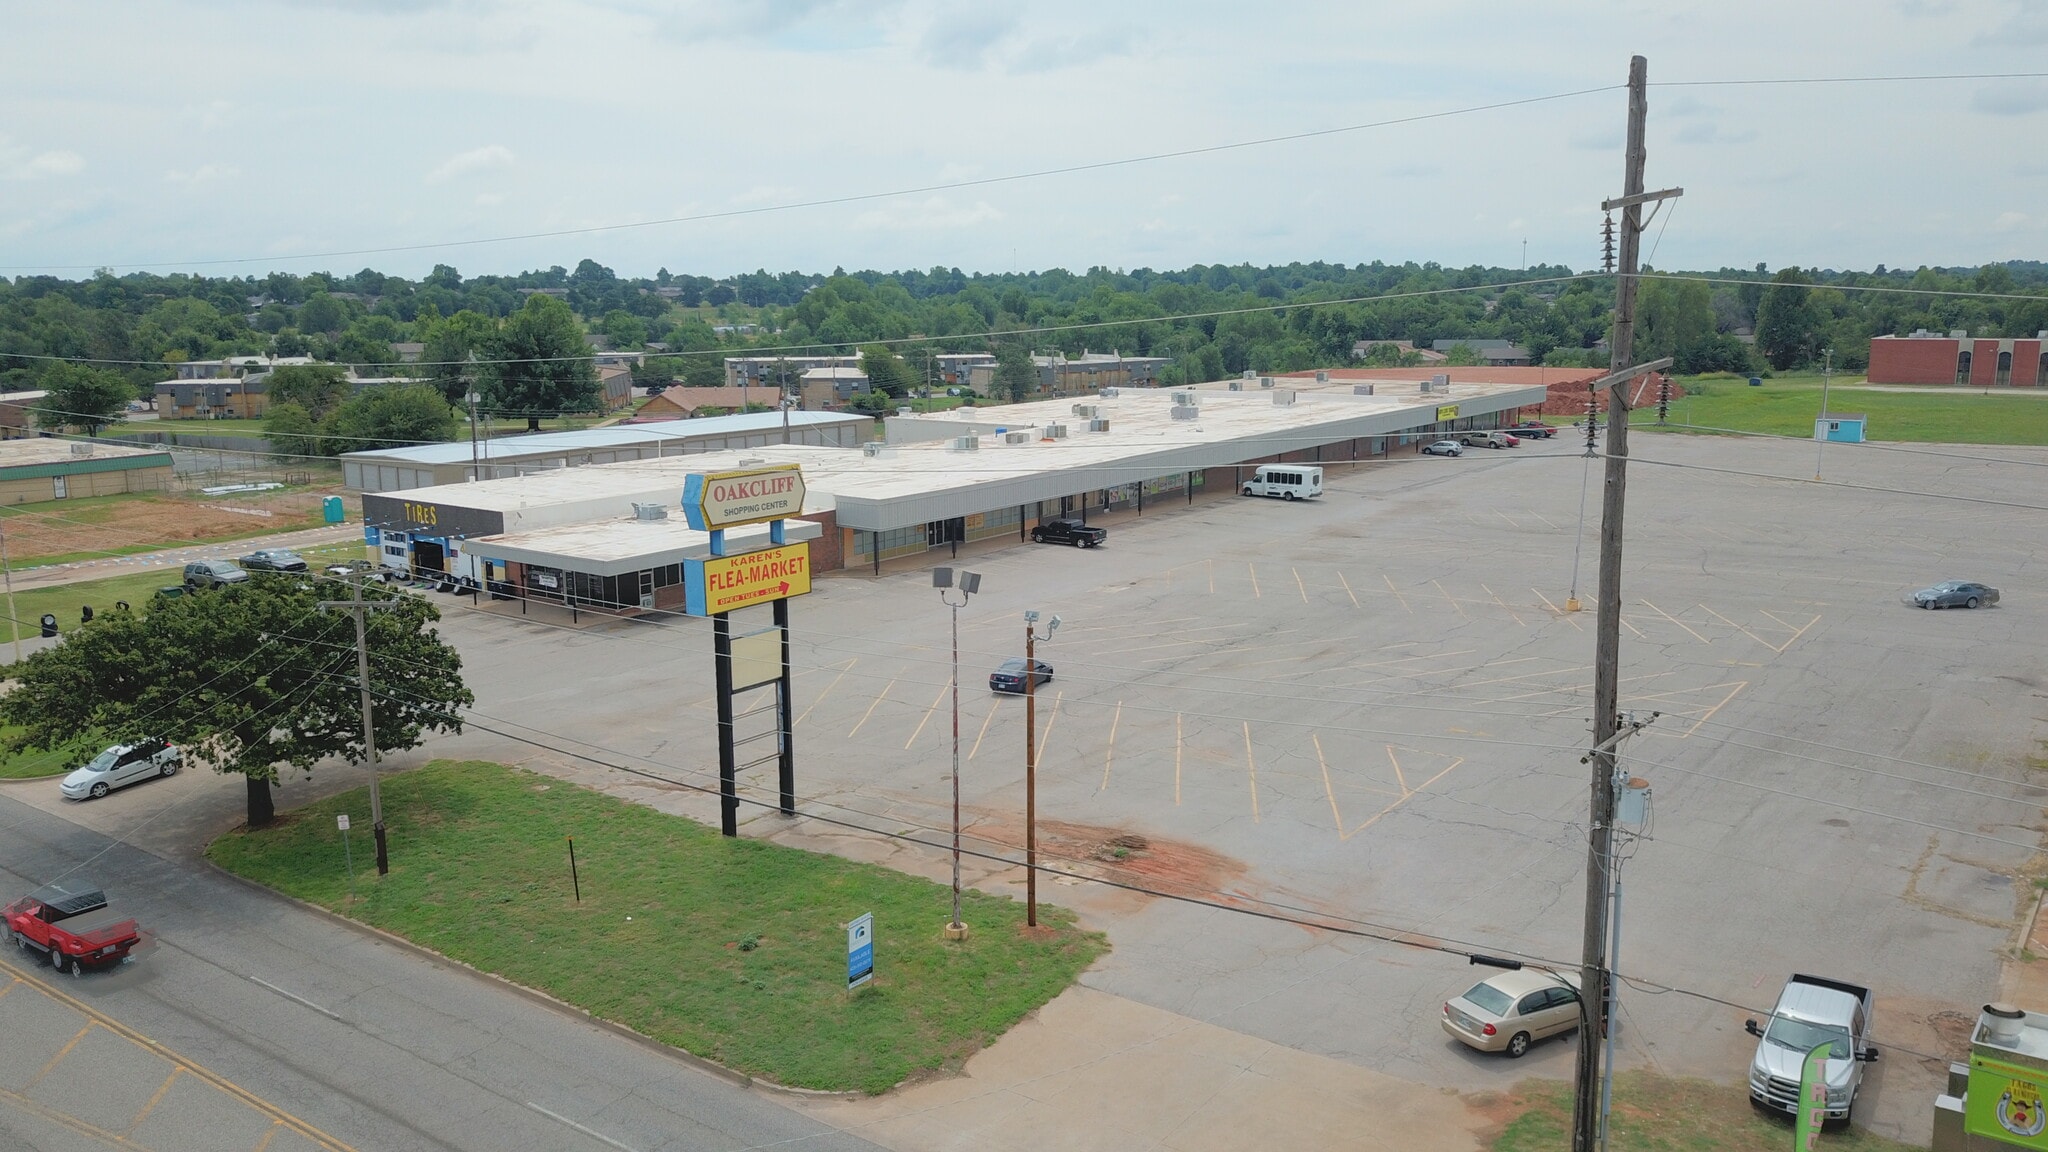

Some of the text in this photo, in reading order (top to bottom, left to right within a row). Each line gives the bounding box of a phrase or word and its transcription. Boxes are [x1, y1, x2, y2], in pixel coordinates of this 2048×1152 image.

[714, 476, 795, 503] OAKCLIFF
[404, 502, 437, 525] TIRES
[724, 500, 788, 517] SHOPPING CENTER
[730, 550, 782, 567] KAREN'S
[709, 556, 805, 592] FLEA-MARKET
[720, 594, 740, 605] OPEN
[742, 590, 760, 600] TUES
[765, 586, 780, 596] SUN
